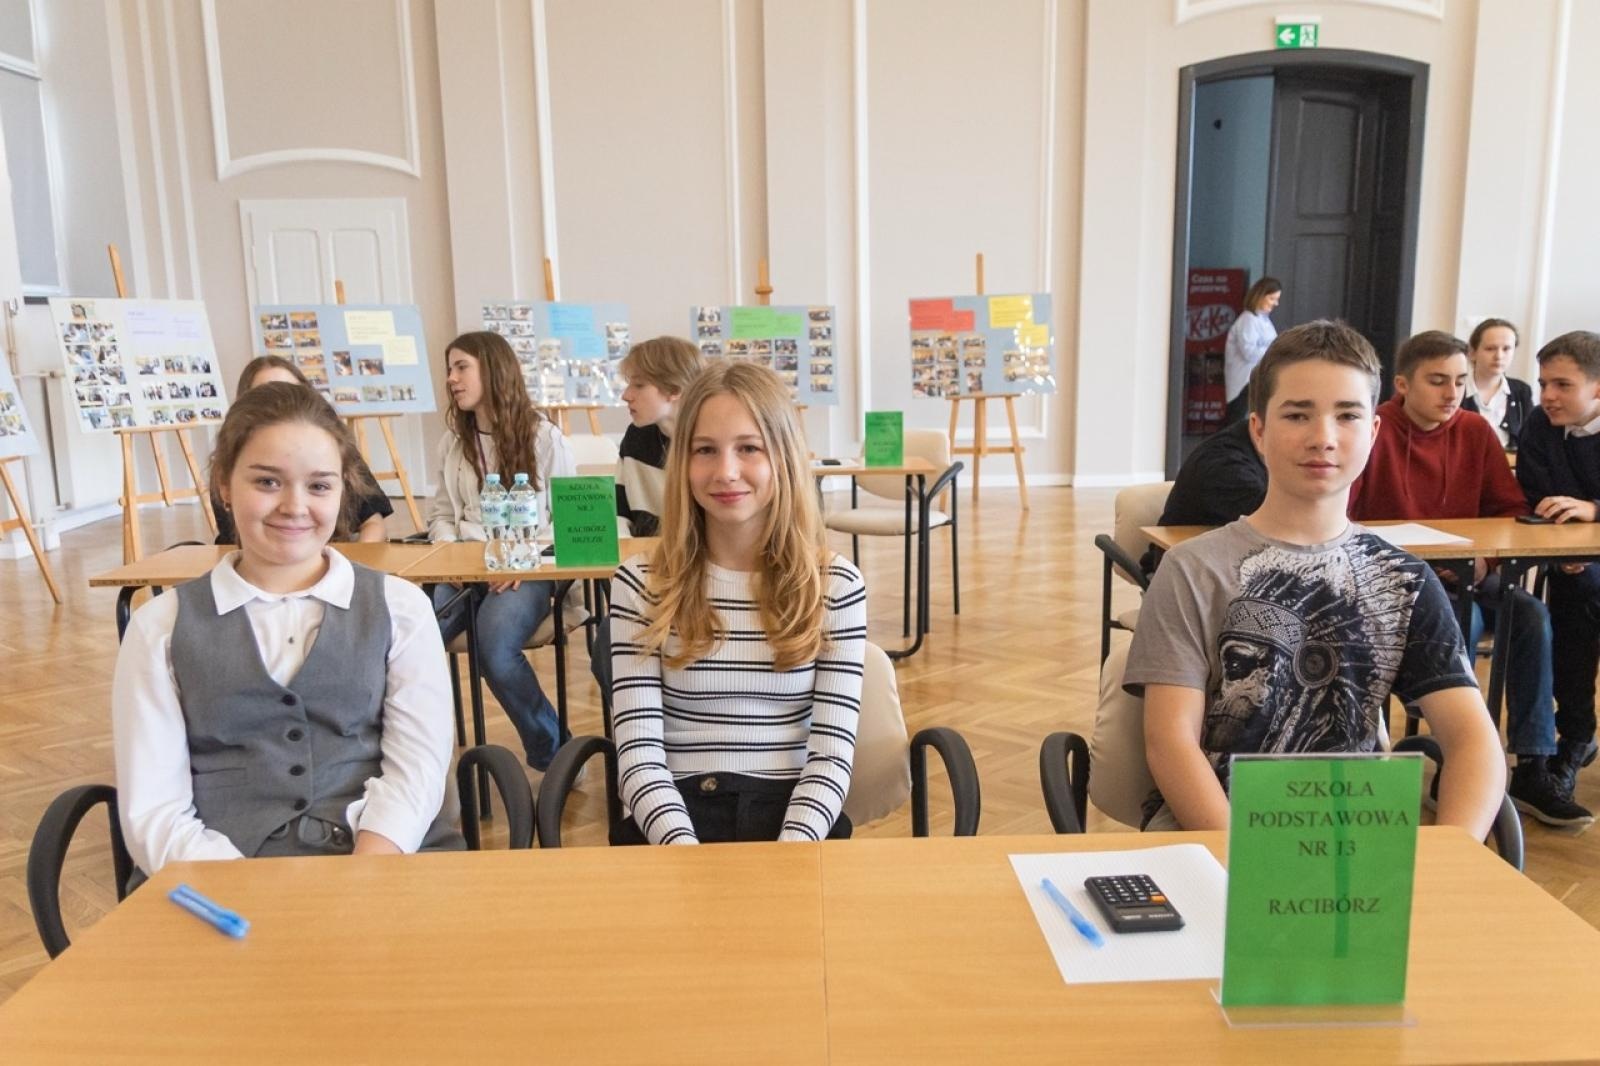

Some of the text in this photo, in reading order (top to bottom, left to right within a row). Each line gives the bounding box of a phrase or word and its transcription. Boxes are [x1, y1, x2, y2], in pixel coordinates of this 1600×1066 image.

[1191, 273, 1228, 284] Czas na
[1287, 780, 1374, 797] SZKOŁA
[1249, 811, 1409, 827] PODSTAWOWA
[1298, 839, 1356, 856] NR 13
[1269, 895, 1380, 914] RACIBÓRZ
